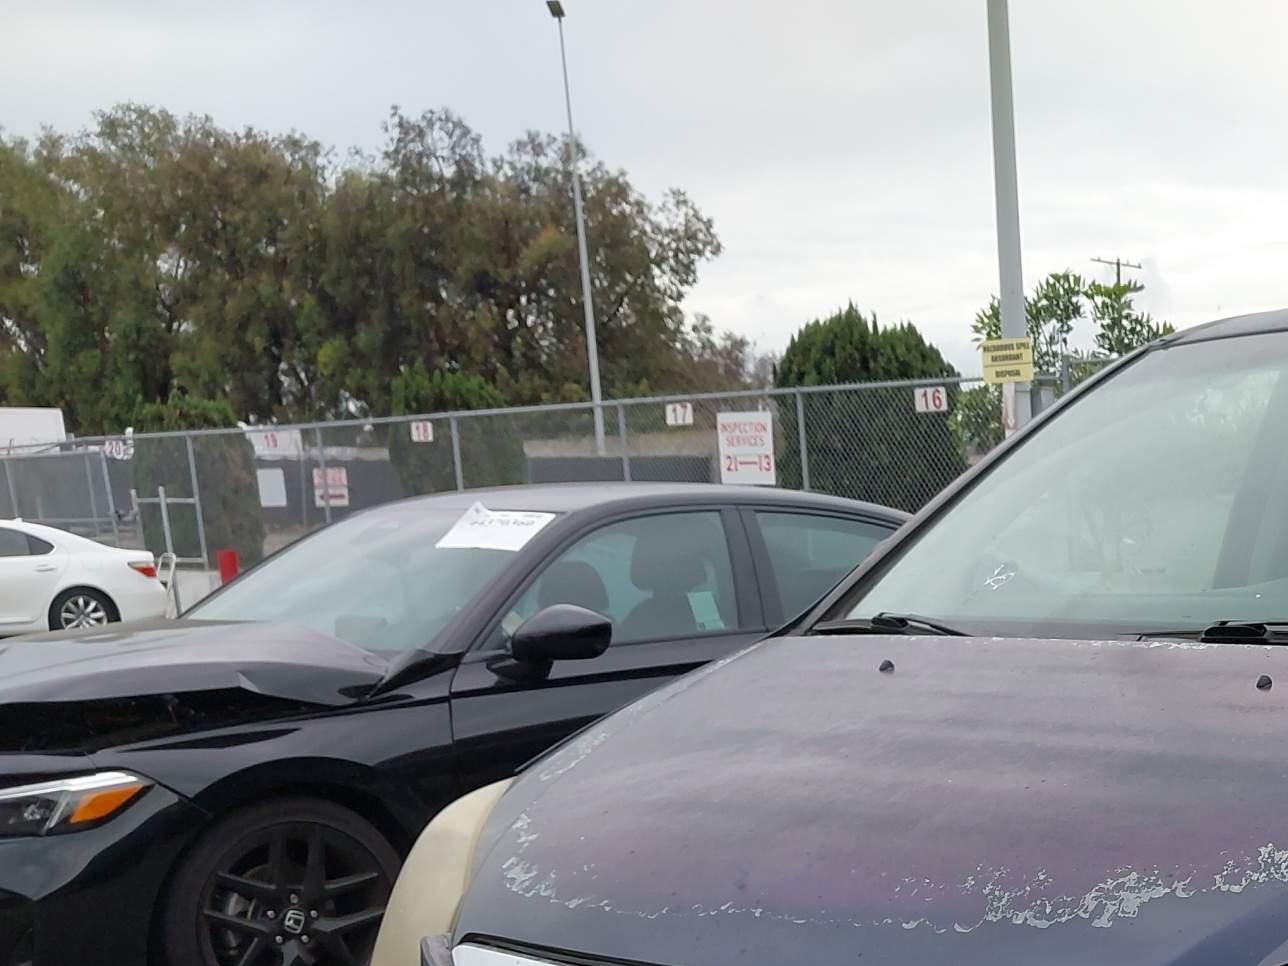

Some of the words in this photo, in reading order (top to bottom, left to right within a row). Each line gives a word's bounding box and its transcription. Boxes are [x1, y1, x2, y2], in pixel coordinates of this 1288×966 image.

[920, 388, 944, 411] 16
[671, 405, 690, 425] 17
[414, 423, 432, 441] 18
[720, 421, 768, 434] INSPECTION
[725, 435, 766, 447] SERVICES
